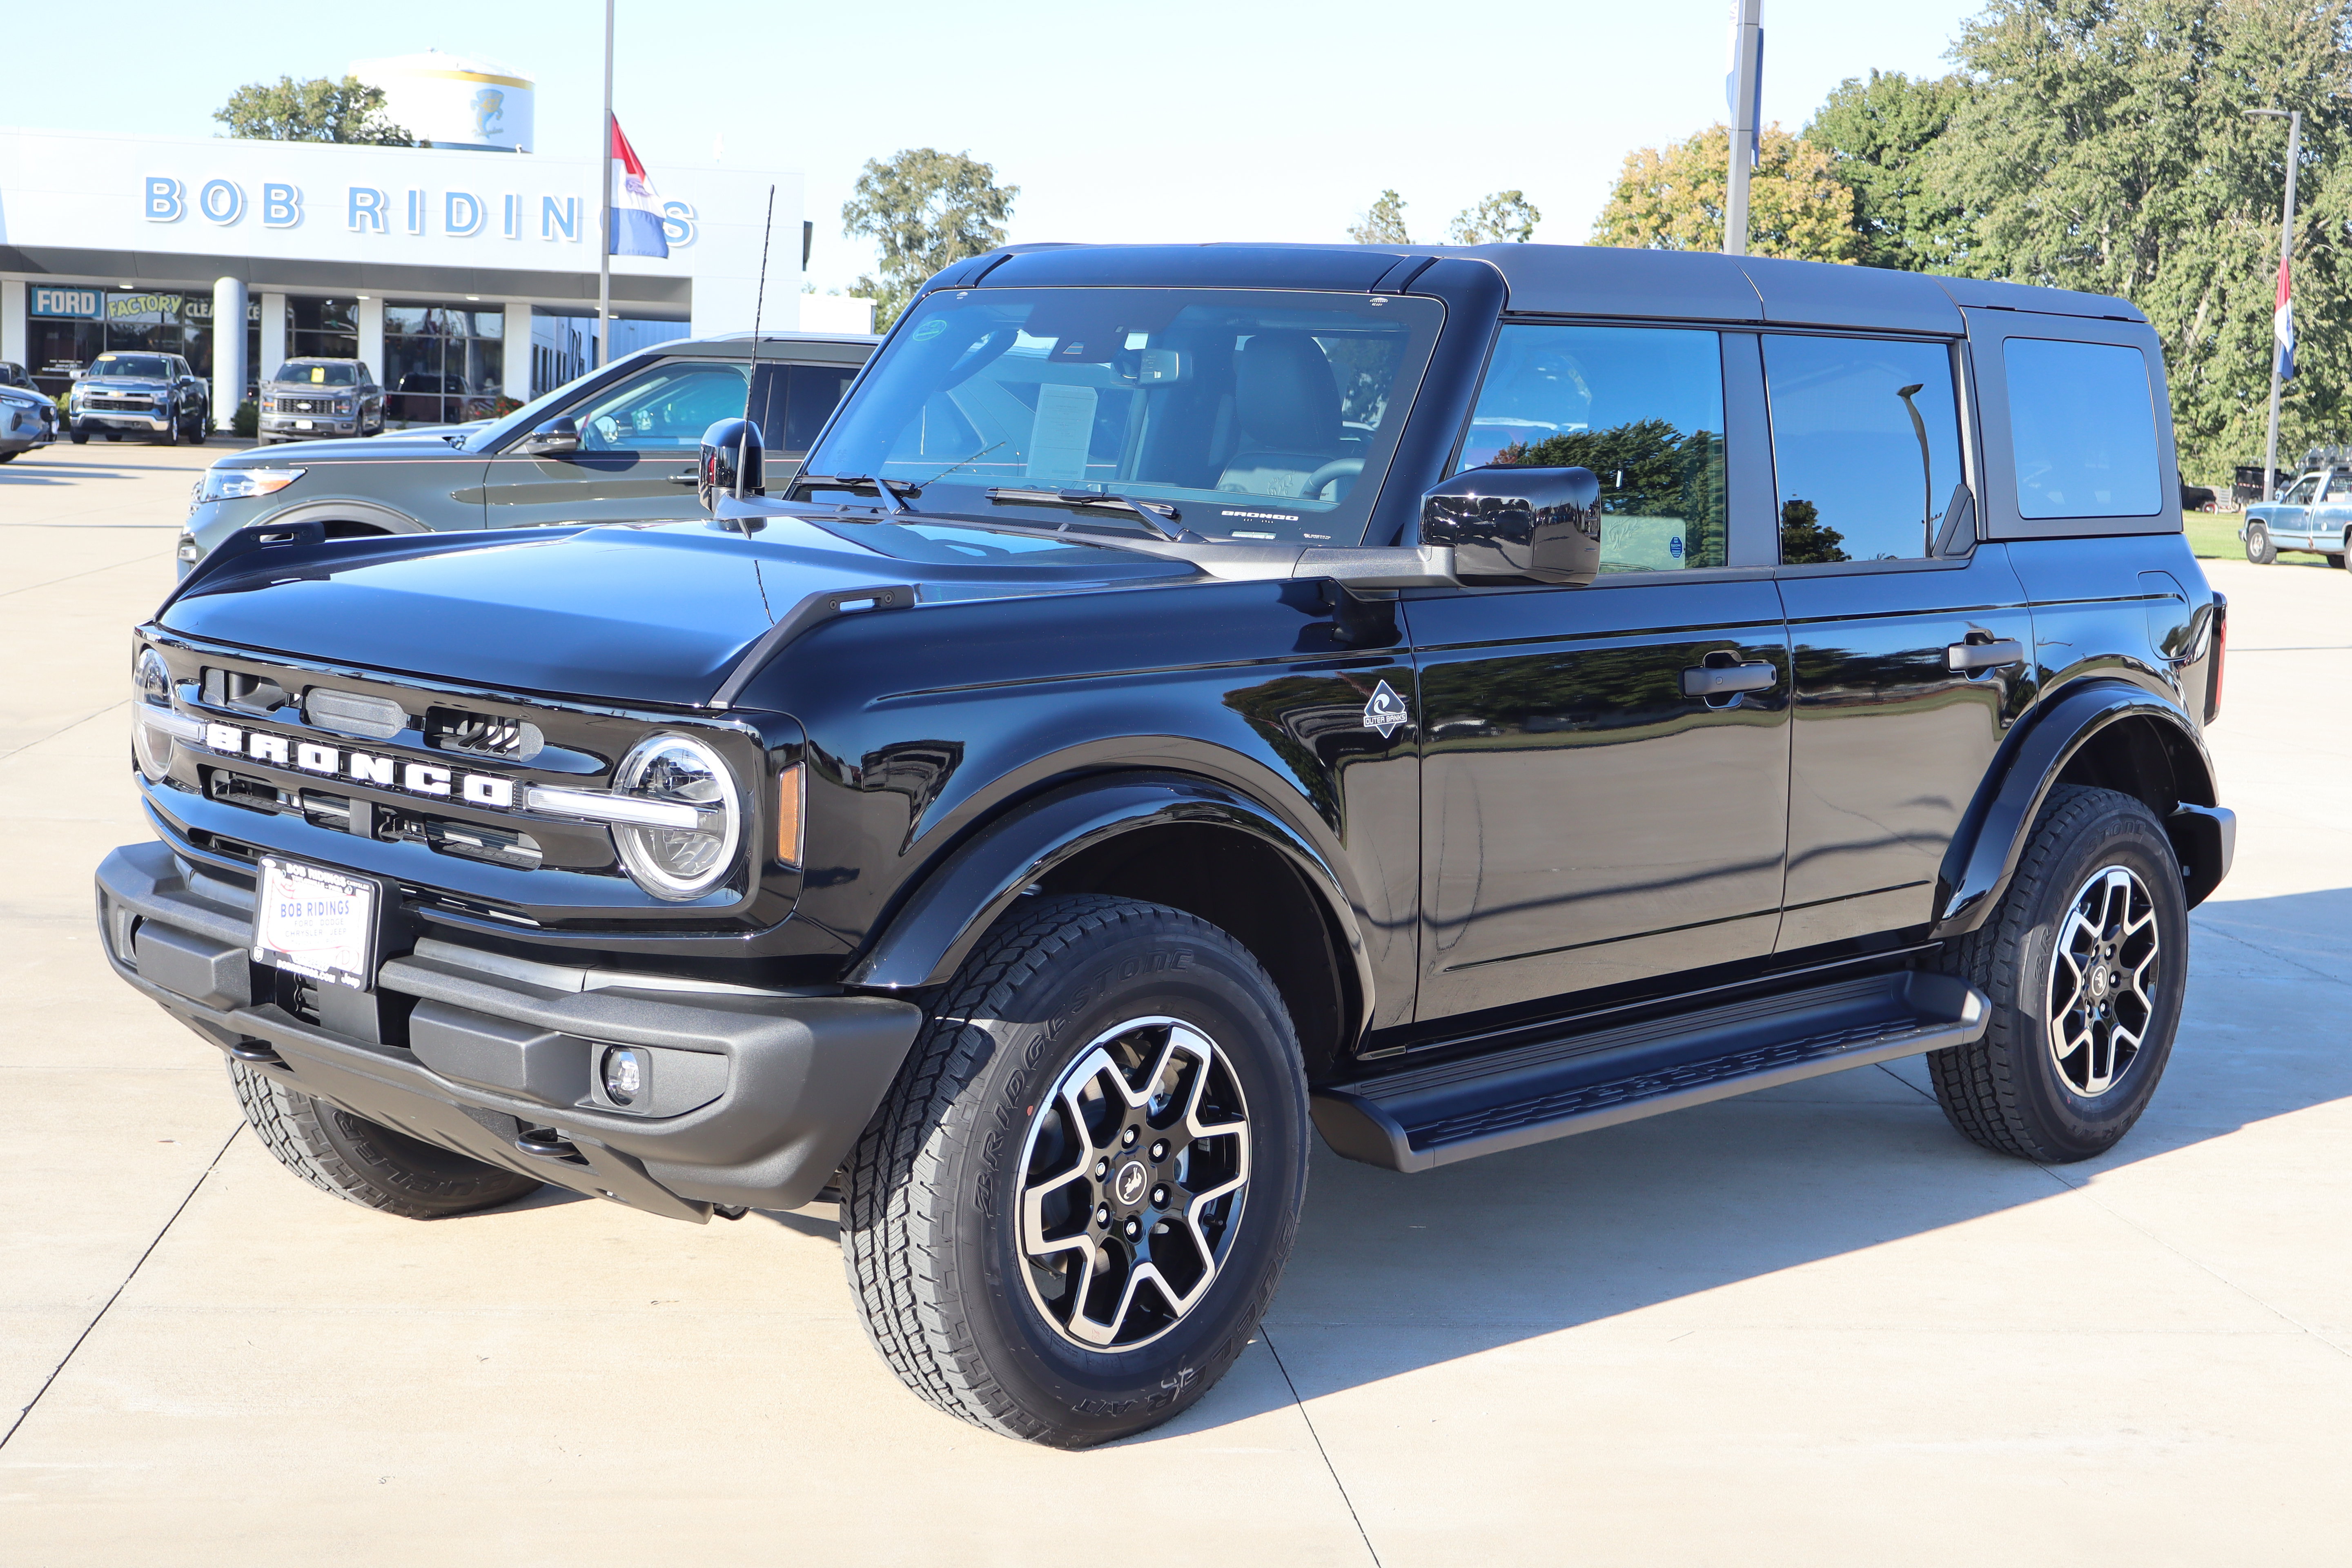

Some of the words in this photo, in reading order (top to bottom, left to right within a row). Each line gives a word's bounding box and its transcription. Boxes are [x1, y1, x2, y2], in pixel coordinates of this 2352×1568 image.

[145, 177, 301, 228] BOB
[348, 186, 694, 247] RIDINS
[37, 290, 96, 315] FORD
[108, 294, 183, 318] FACTORY
[185, 302, 260, 320] CLEACE
[1221, 510, 1299, 521] BRONCO
[1365, 716, 1385, 725] OUTER
[1386, 714, 1405, 722] BANKS
[207, 723, 513, 807] BRONCO
[285, 862, 306, 877] BOB
[307, 868, 347, 887] RIDINGS
[281, 902, 302, 918] BOB
[307, 900, 349, 917] RIDINGS
[285, 929, 323, 938] CHRYSLER
[971, 947, 1194, 1218] BRIDGESTONE
[1145, 1208, 1296, 1413] DUELER
